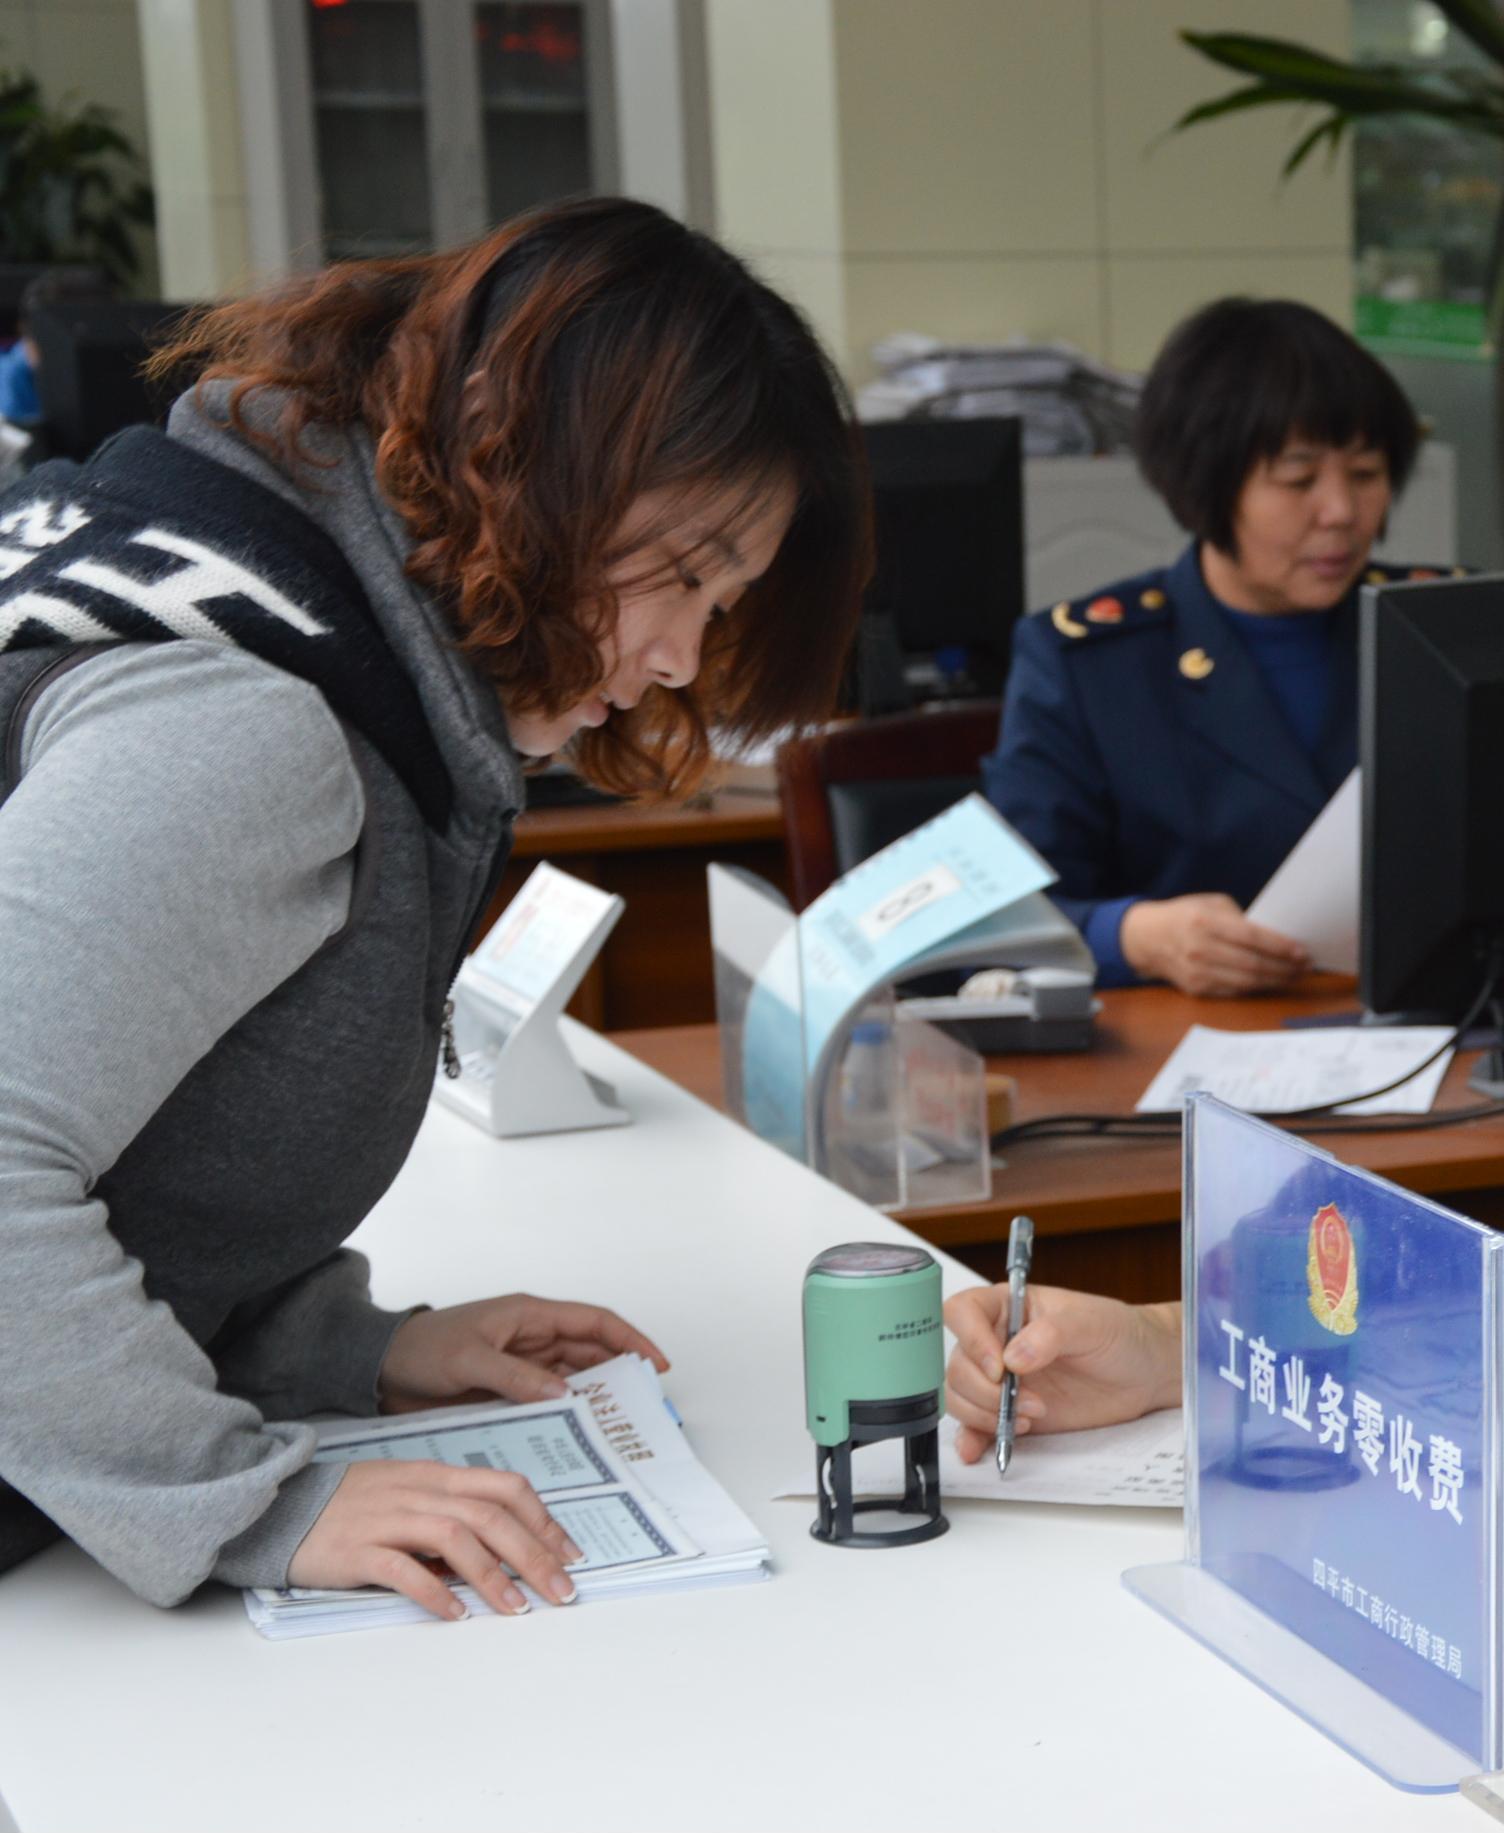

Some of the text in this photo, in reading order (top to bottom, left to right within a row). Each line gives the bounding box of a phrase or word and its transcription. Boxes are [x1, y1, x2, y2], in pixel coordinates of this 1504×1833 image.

[1219, 1319, 1464, 1525] 工商业务零收费
[1313, 1557, 1462, 1679] 四平市工商行政管理局
